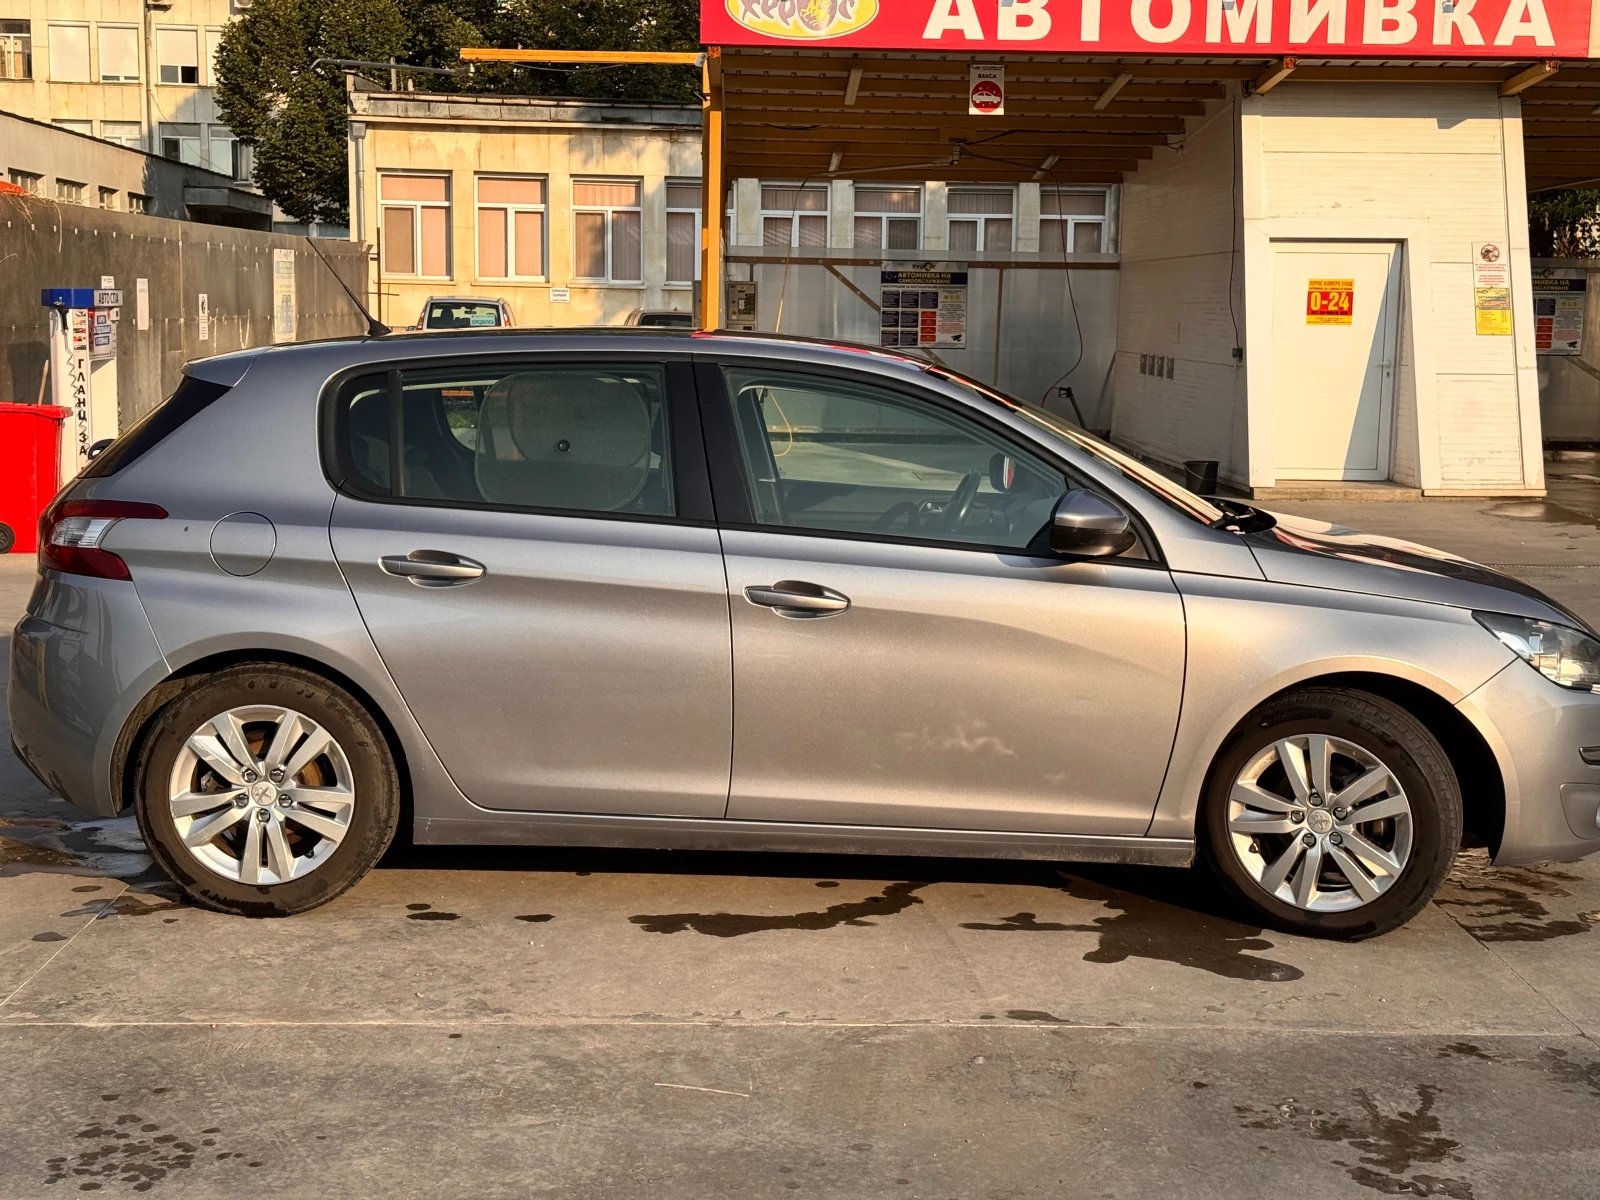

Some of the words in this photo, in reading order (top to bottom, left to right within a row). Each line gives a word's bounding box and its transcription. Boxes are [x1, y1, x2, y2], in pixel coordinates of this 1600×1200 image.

[1310, 291, 1349, 310] 0-24
[77, 358, 87, 422] ГЛАНЦ
[79, 432, 87, 455] ЗА
